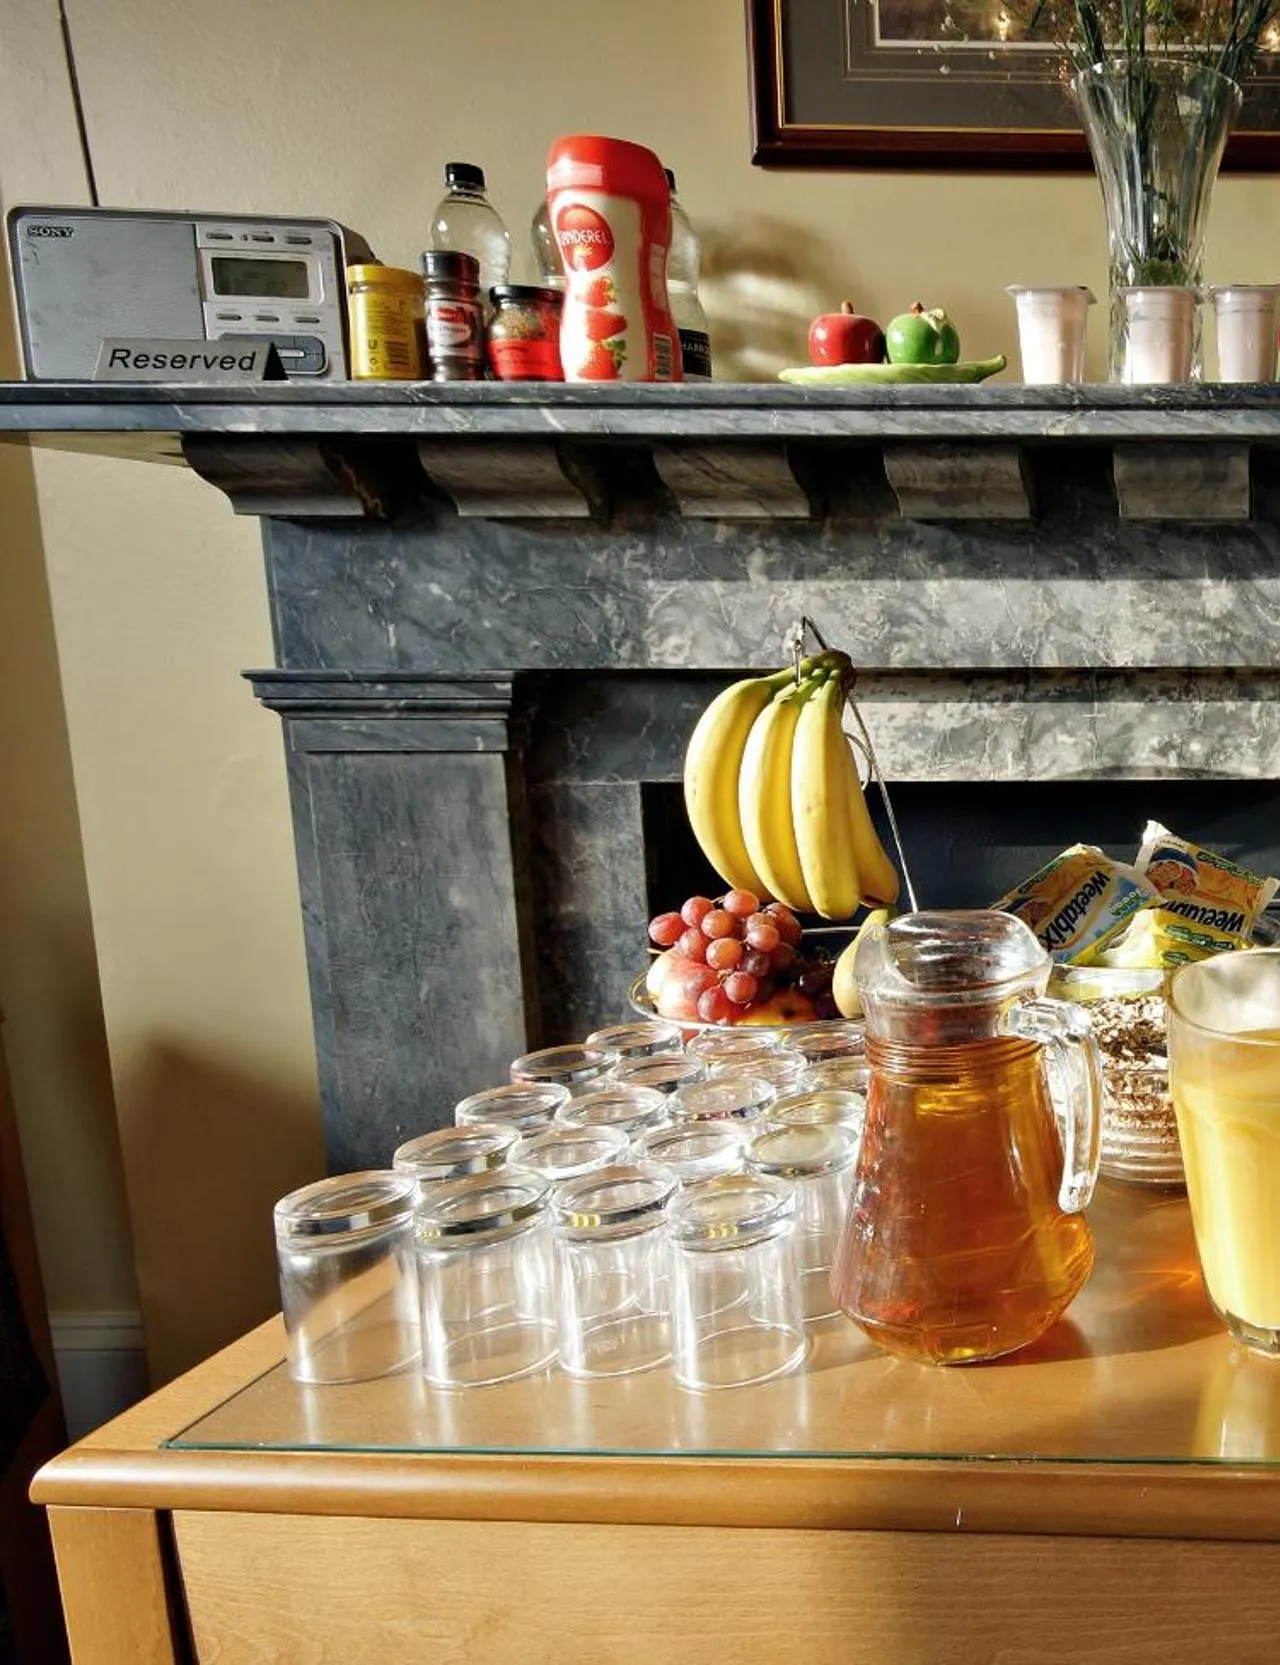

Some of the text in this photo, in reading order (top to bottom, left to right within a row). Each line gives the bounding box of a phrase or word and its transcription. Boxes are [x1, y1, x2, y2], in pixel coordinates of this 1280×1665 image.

[26, 225, 75, 238] SONY
[107, 347, 257, 372] Reserved
[1038, 870, 1111, 953] Weetabix
[1160, 900, 1246, 933] Weetab
